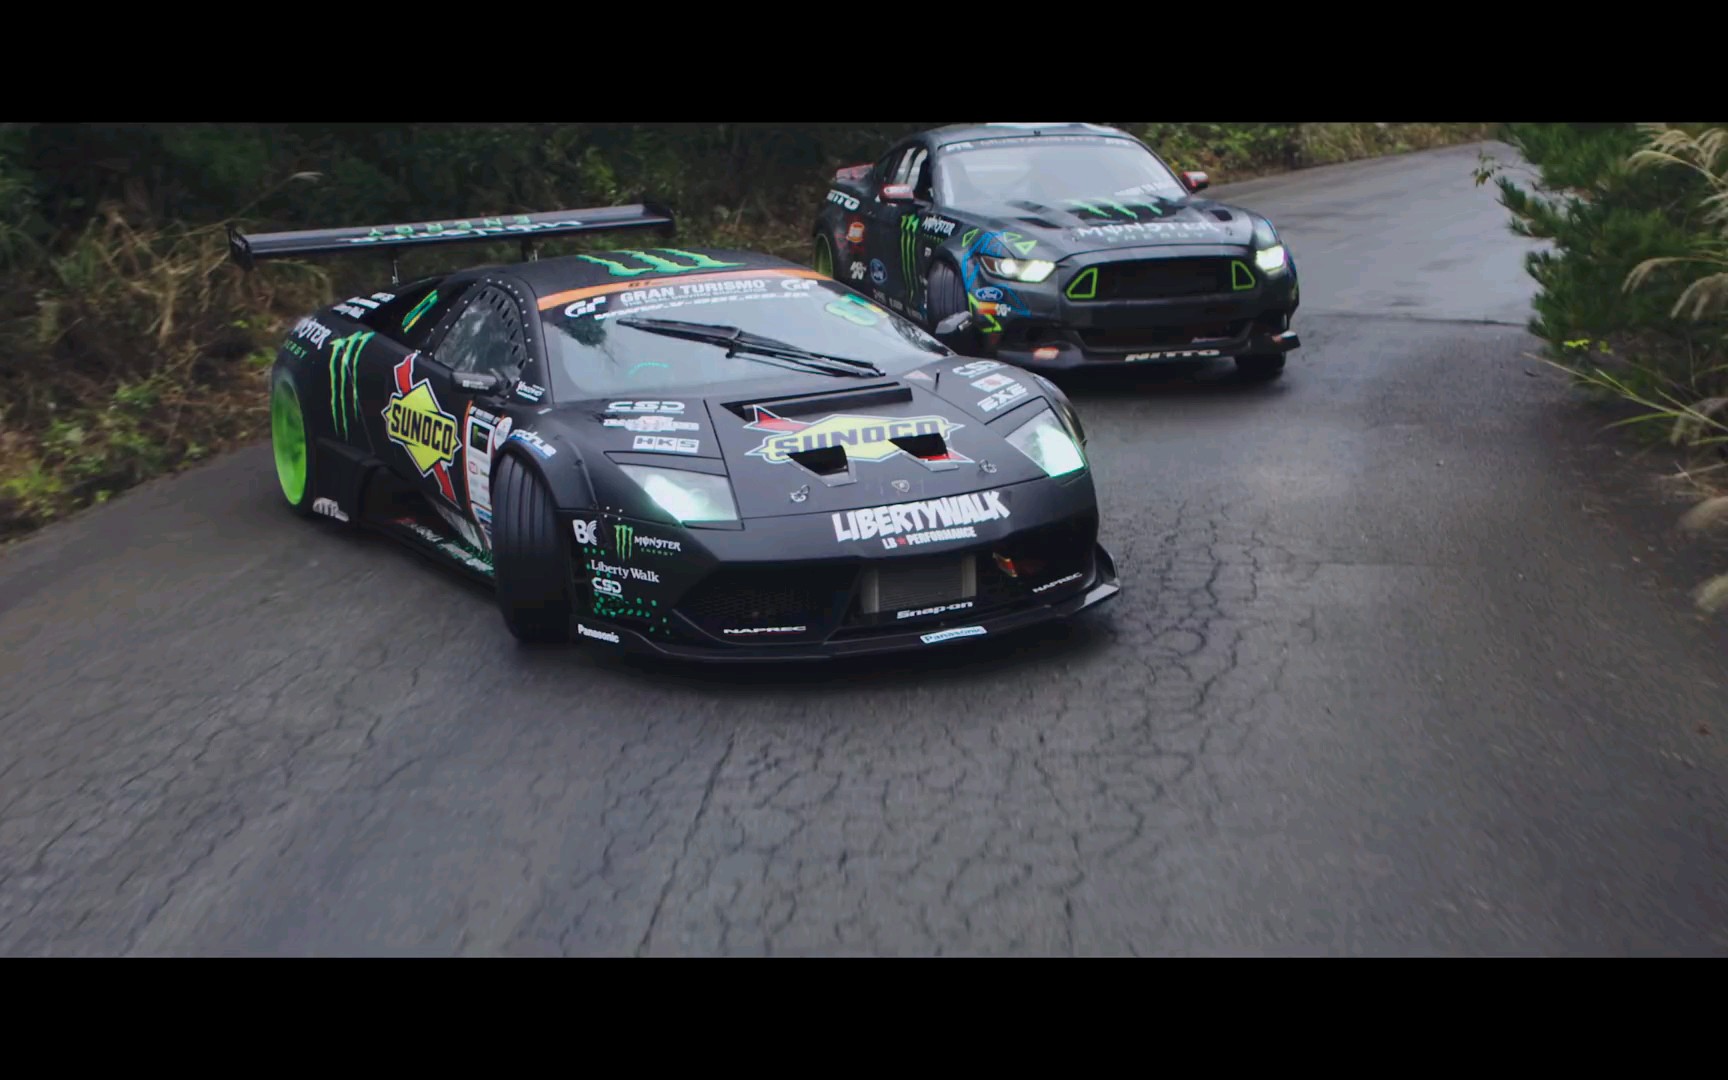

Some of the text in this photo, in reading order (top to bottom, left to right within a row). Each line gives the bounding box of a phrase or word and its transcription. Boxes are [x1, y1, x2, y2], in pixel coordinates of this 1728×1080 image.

[620, 279, 766, 303] GRAN TURISMO
[608, 401, 685, 411] CSD
[390, 403, 454, 457] SUNOCO
[774, 420, 942, 459] SUNOCO
[831, 491, 1010, 542] LIBERTYWALK
[634, 536, 681, 552] MONSTER
[905, 526, 977, 546] PERFORMANCE
[591, 559, 660, 583] Liberty Walk
[591, 576, 622, 595] CSD
[897, 601, 974, 620] Snap-on
[577, 623, 620, 644] Panasonic
[923, 628, 982, 643] Panasonic
